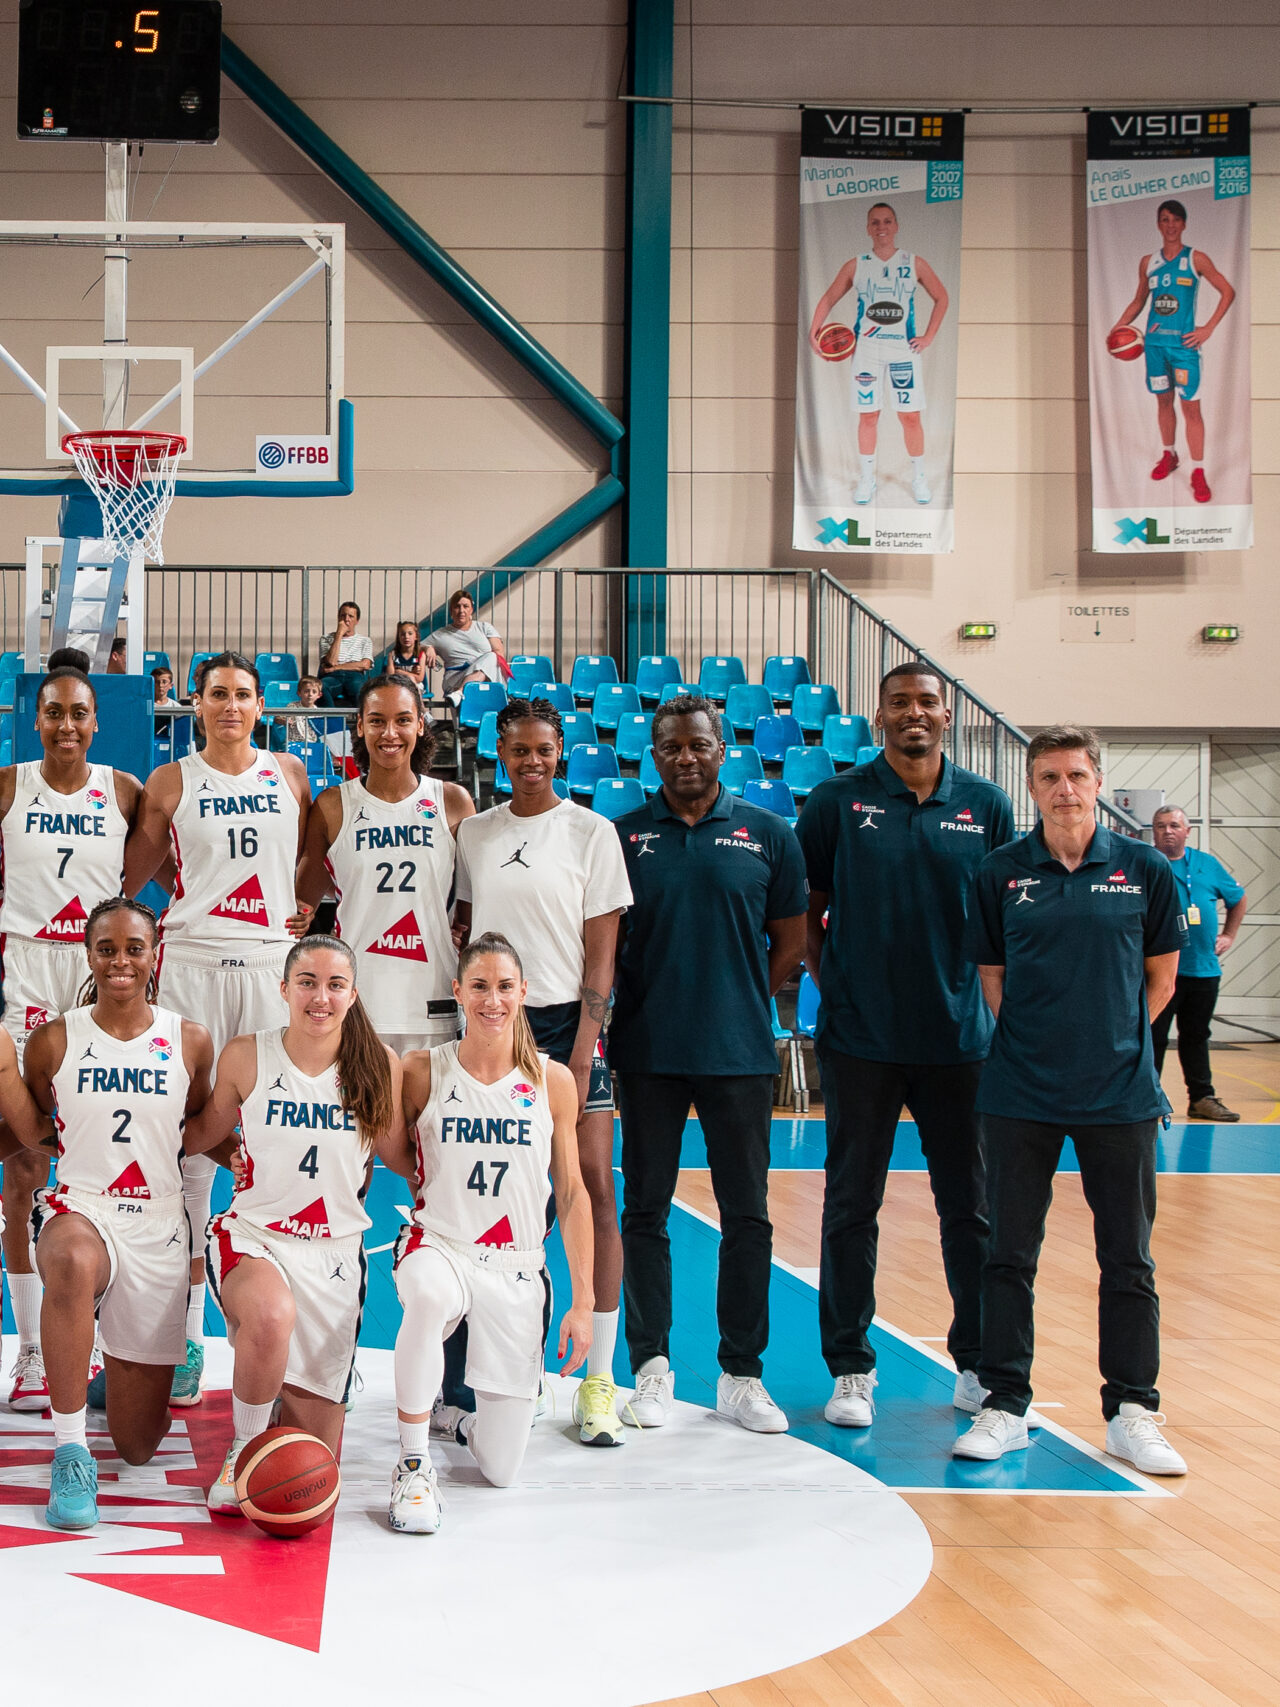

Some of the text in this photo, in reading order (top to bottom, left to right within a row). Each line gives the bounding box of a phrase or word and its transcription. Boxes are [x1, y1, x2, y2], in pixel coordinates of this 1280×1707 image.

[824, 114, 916, 136] VISIO
[1110, 114, 1202, 136] VISIO
[804, 165, 854, 182] Marion
[932, 172, 960, 183] 2007
[1091, 168, 1132, 184] Anaïs
[1219, 166, 1248, 179] 2006
[826, 176, 900, 197] LABORDE
[930, 186, 960, 198] 2015
[1090, 170, 1211, 202] LE GLUHER CANO
[1219, 182, 1248, 194] 2016
[897, 266, 911, 278] 12
[1162, 273, 1171, 287] 8
[876, 308, 904, 318] SEVER
[897, 392, 910, 404] 12
[288, 446, 329, 464] FFBB
[814, 517, 870, 546] XL
[875, 530, 932, 539] Département
[1112, 517, 1170, 546] XL
[1174, 527, 1232, 536] Département
[893, 540, 923, 548] Landes
[1192, 536, 1224, 544] Landes
[1068, 606, 1130, 616] TOILETTES
[198, 794, 280, 818] FRANCE
[25, 812, 106, 837] FRANCE
[940, 822, 984, 834] FRANCE
[228, 827, 258, 859] 16
[355, 824, 434, 852] FRANCE
[714, 838, 762, 852] FRANCE
[56, 848, 74, 878] 7
[376, 860, 416, 894] 22
[1091, 884, 1142, 894] FRANCE
[220, 898, 265, 914] MAIF
[46, 919, 88, 934] MAIF
[377, 934, 422, 950] MAIF
[221, 959, 245, 968] FRA
[77, 1068, 168, 1096] FRANCE
[265, 1100, 356, 1132] FRANCE
[112, 1109, 132, 1144] 2
[441, 1117, 532, 1146] FRANCE
[298, 1145, 319, 1180] 4
[466, 1161, 510, 1197] 47
[118, 1204, 142, 1213] FRA
[280, 1219, 330, 1238] MAIF
[284, 1478, 326, 1502] molten
